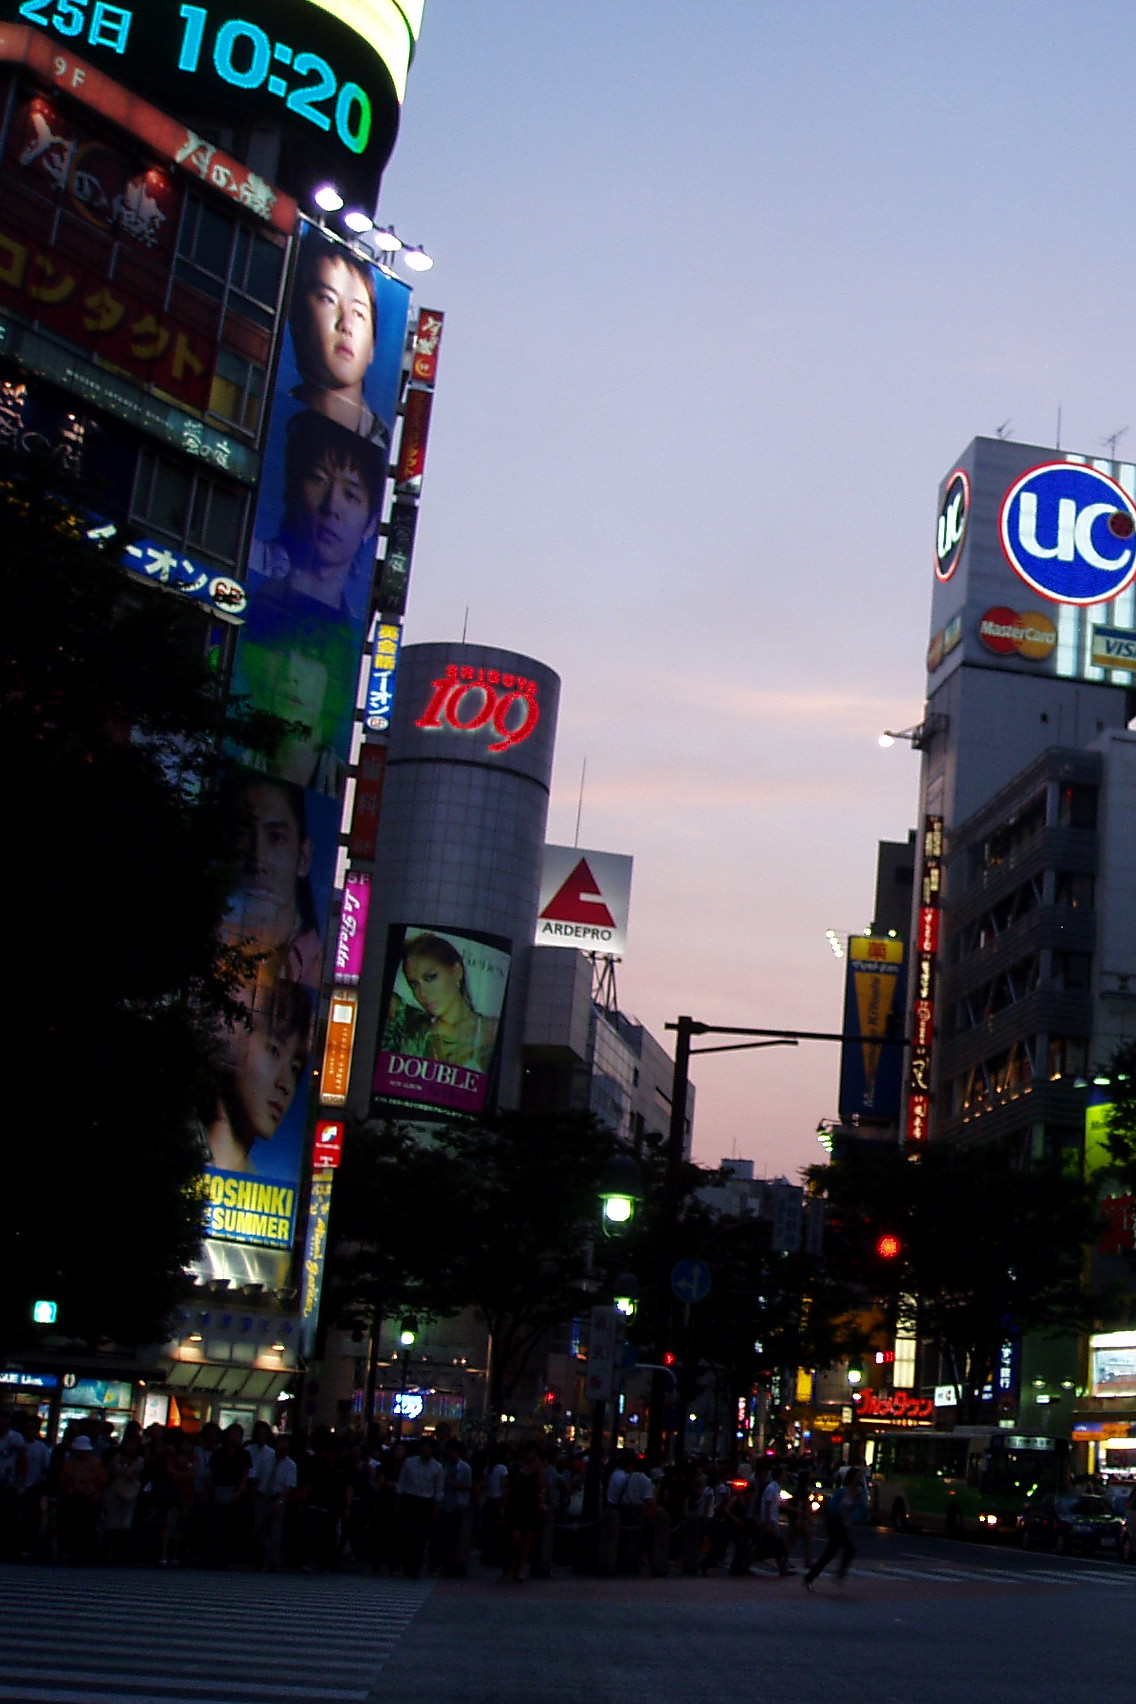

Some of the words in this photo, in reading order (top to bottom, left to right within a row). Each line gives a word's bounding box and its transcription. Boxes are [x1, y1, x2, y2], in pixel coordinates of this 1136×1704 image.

[177, 3, 373, 154] 10:20
[1018, 491, 1133, 572] UC
[980, 620, 1057, 644] MasterCard
[368, 670, 392, 714] イーオン
[415, 677, 540, 752] 109
[542, 922, 612, 942] ARDEPRO
[387, 1055, 480, 1093] DOUBLE
[211, 1207, 291, 1240] SUMMER
